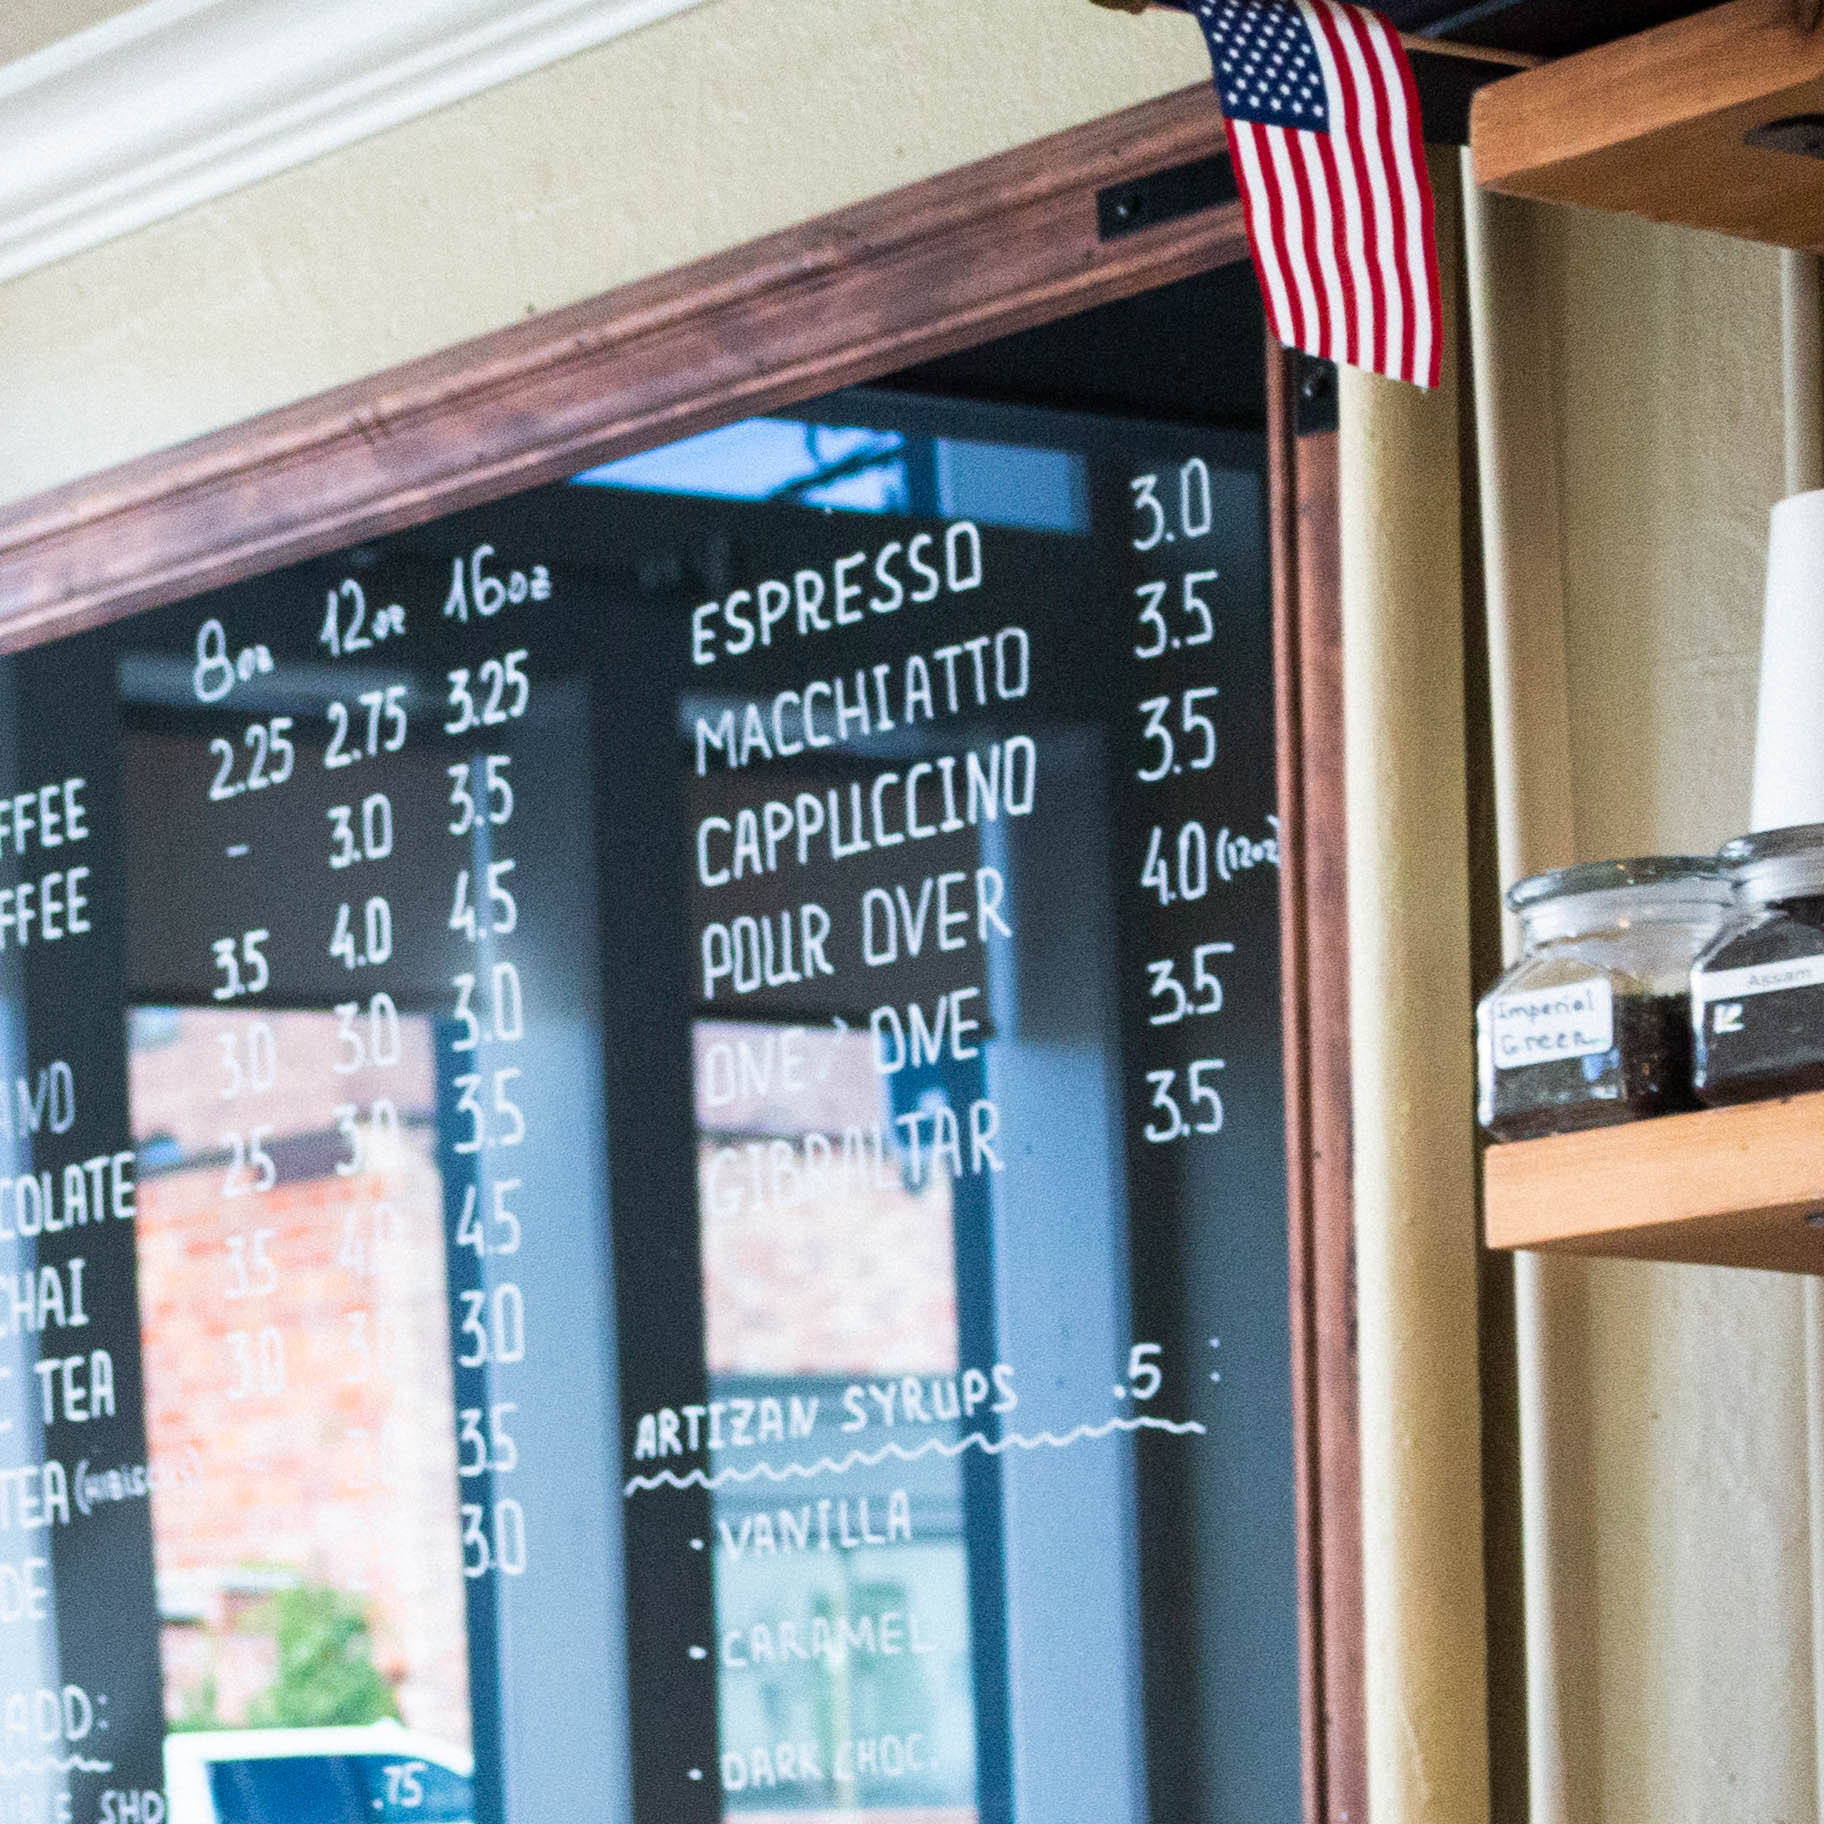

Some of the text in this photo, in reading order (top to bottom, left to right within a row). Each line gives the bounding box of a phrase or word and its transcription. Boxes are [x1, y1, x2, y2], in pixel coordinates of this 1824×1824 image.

[444, 544, 552, 624] 16oz
[691, 457, 1213, 666] ESPRESSO 3.0
[694, 570, 1220, 777] MACCHIATTO 3.5
[209, 716, 297, 801] 2.25
[324, 686, 408, 769] 2.75
[445, 649, 530, 734] 3.25
[328, 794, 393, 869] 3.0
[448, 755, 515, 835] 3.5
[695, 687, 1220, 888] CAPPUCCINO 3.5
[212, 930, 271, 1001] 3.5
[329, 897, 394, 969] 4.0
[449, 860, 517, 941] 4.5
[700, 903, 835, 1000] POUR
[861, 866, 1015, 967] OVER
[1141, 819, 1208, 906] 4.0
[452, 961, 524, 1052] 3.0
[704, 942, 1235, 1108] ONE ONE 3.5
[454, 1067, 526, 1154] 3.5
[1144, 1058, 1227, 1143] 3.5
[456, 1178, 522, 1257] 4.5
[33, 1348, 119, 1425] TEA
[459, 1281, 526, 1368] 3.0
[458, 1402, 520, 1478] 3.5
[634, 1396, 820, 1460] ARTIZAN
[840, 1363, 1021, 1434] SYRUPS
[460, 1497, 528, 1580] 3.0
[715, 1490, 913, 1562] VANILLA
[721, 1610, 932, 1669] CARAMEL
[722, 1741, 824, 1792] DARK
